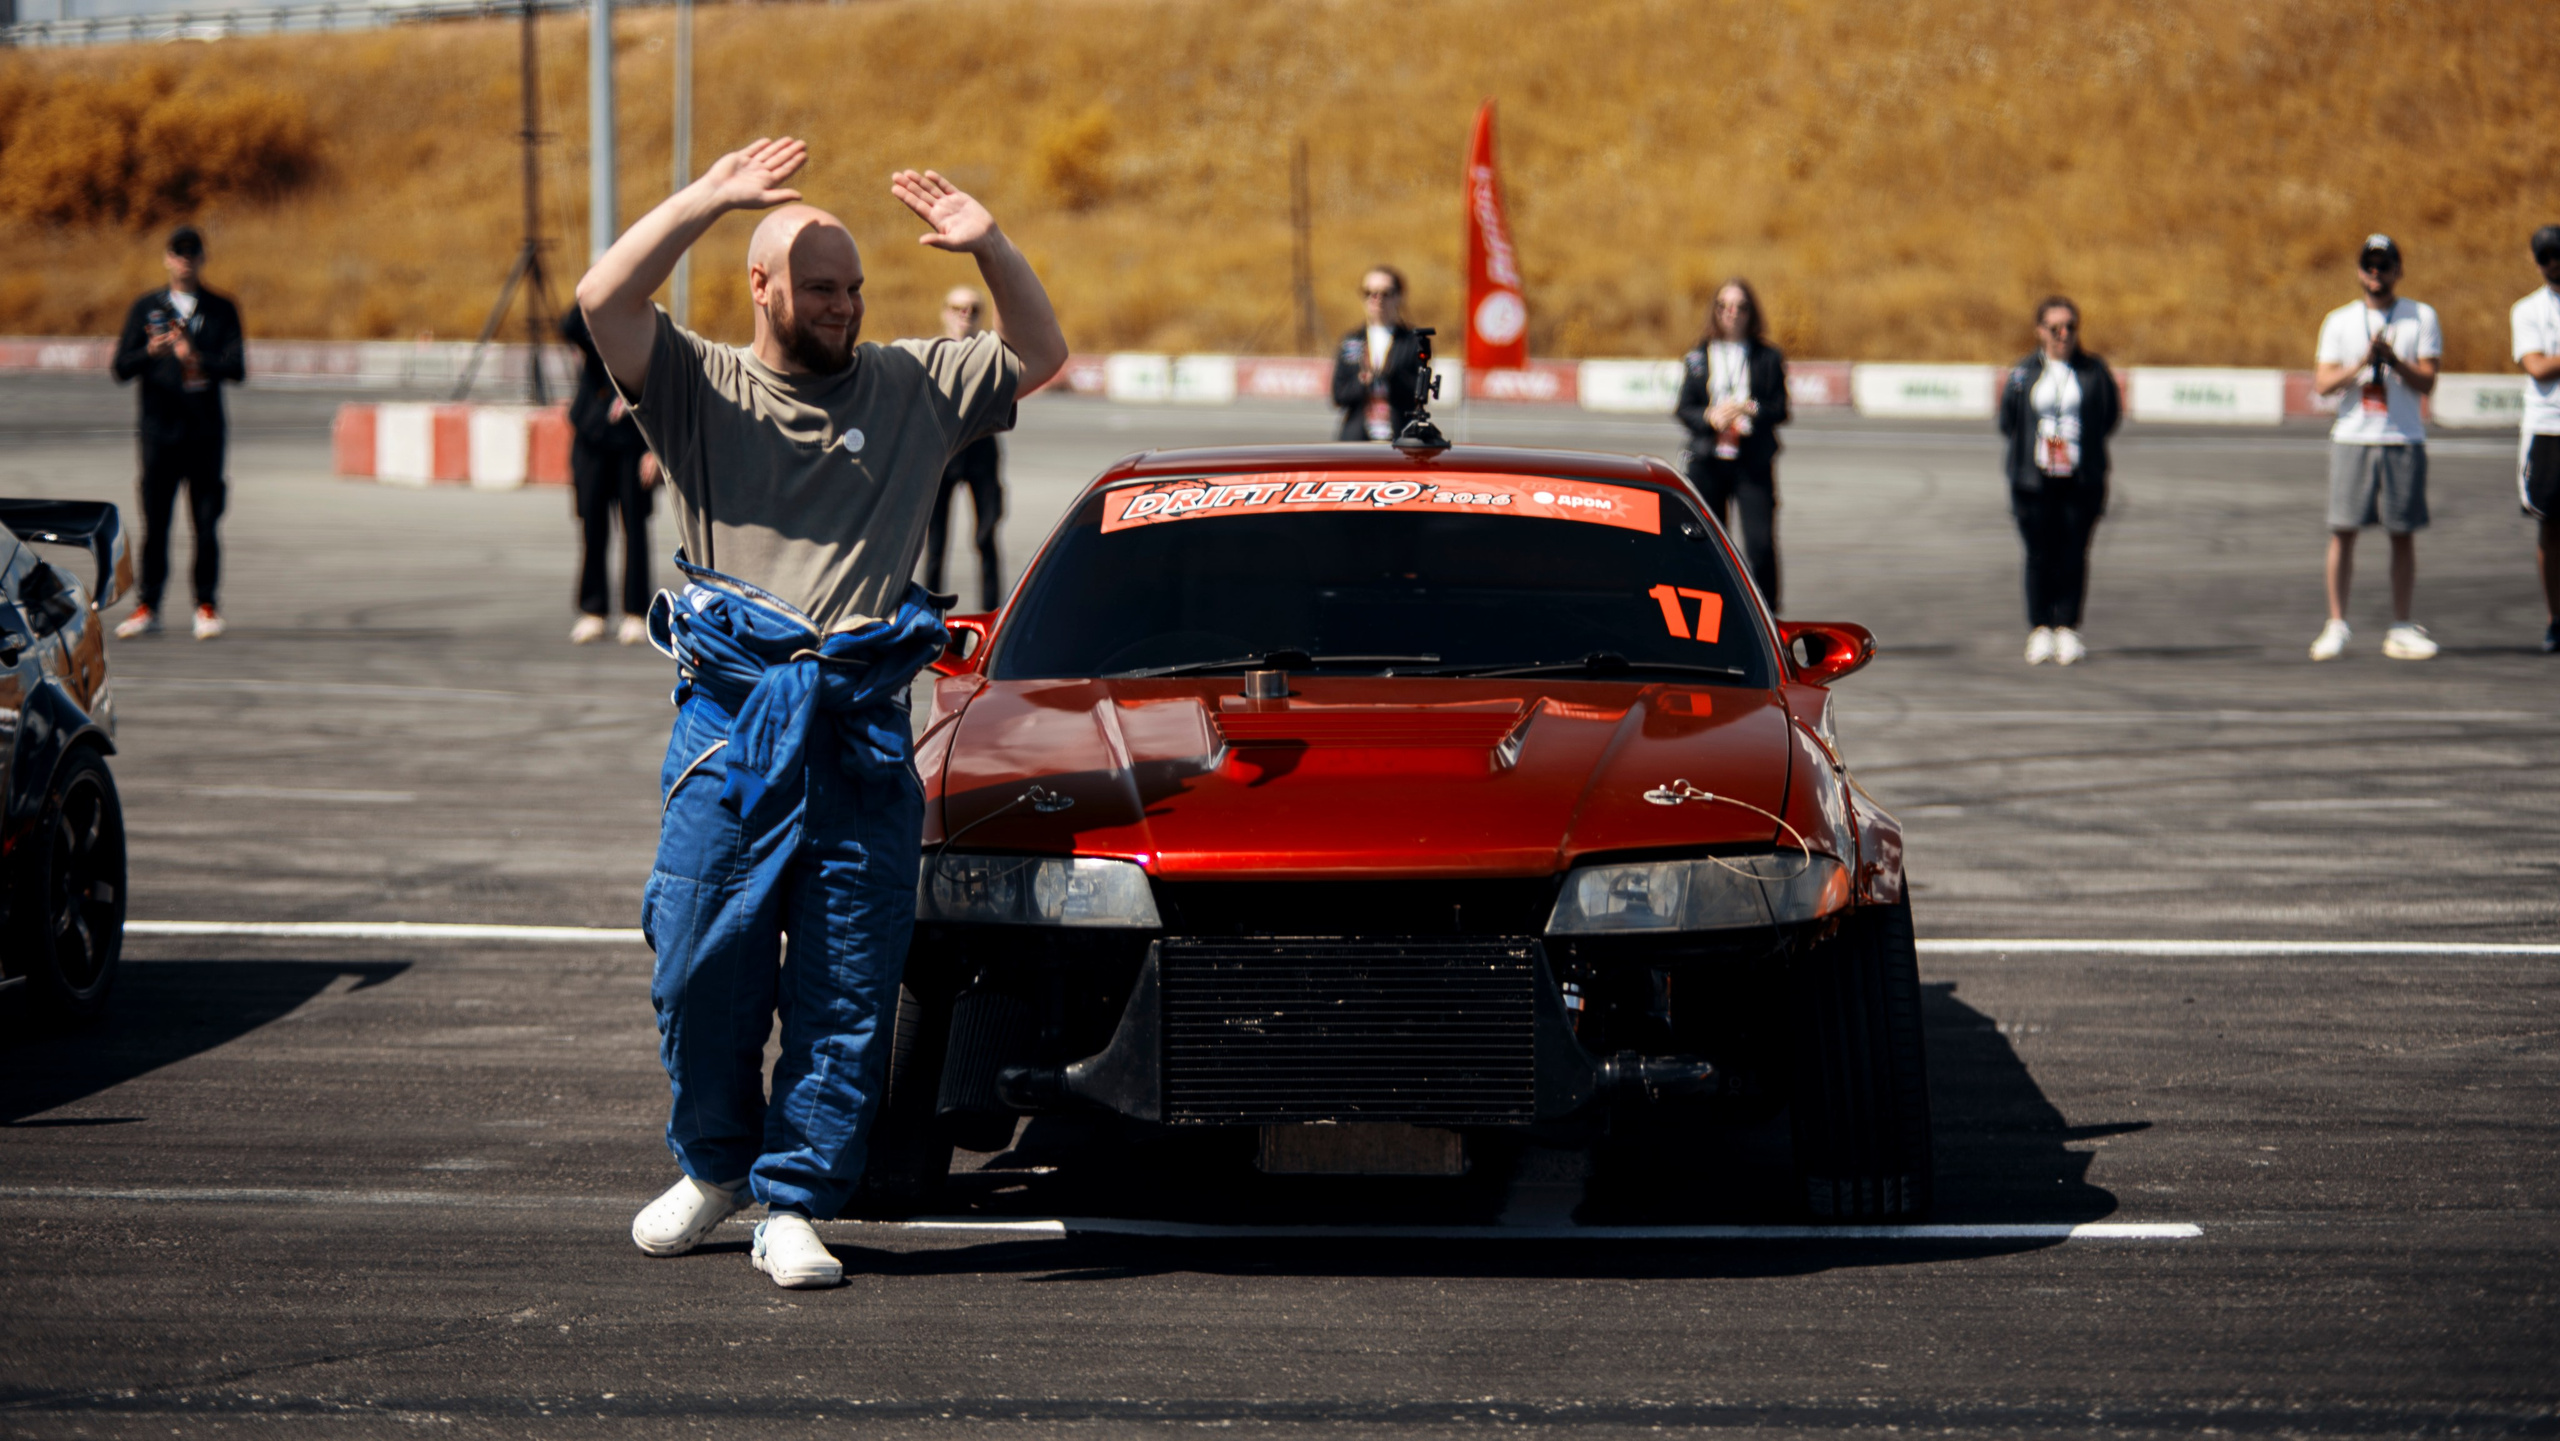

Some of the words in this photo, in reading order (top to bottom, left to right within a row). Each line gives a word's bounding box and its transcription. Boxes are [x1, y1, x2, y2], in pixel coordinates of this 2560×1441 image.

[1121, 482, 1287, 520] DRIFT
[1284, 481, 1422, 504] LETO
[1556, 494, 1612, 510] дром
[1648, 583, 1723, 644] 17
